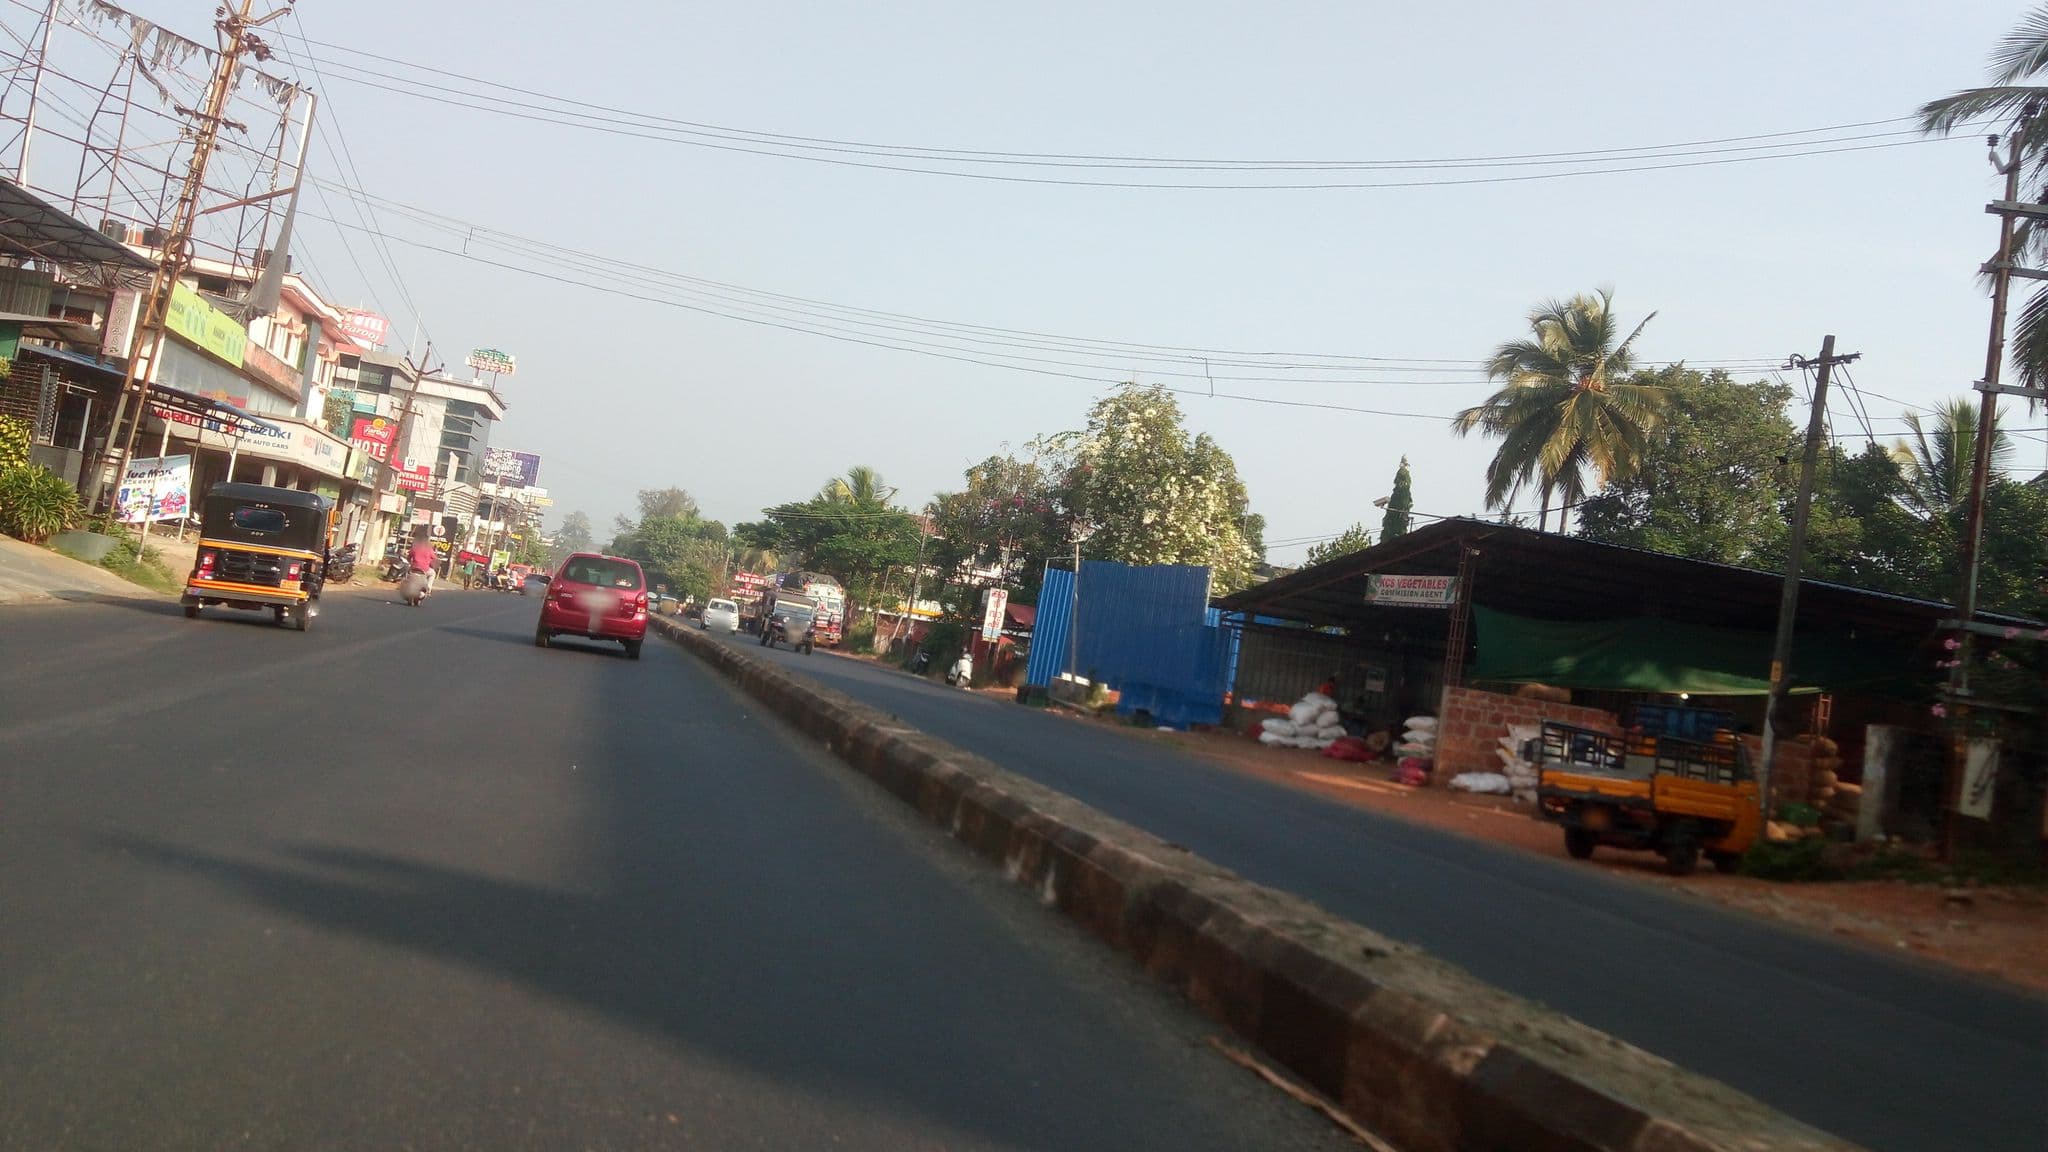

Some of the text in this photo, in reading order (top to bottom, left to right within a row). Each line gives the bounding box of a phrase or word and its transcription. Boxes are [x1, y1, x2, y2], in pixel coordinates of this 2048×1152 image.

[253, 439, 271, 447] AUTO
[126, 469, 147, 479] lue
[399, 472, 428, 482] IVERSAL
[397, 479, 426, 489] STITUTE
[1398, 578, 1449, 590] VEGETABLES
[1420, 591, 1444, 599] AGENT
